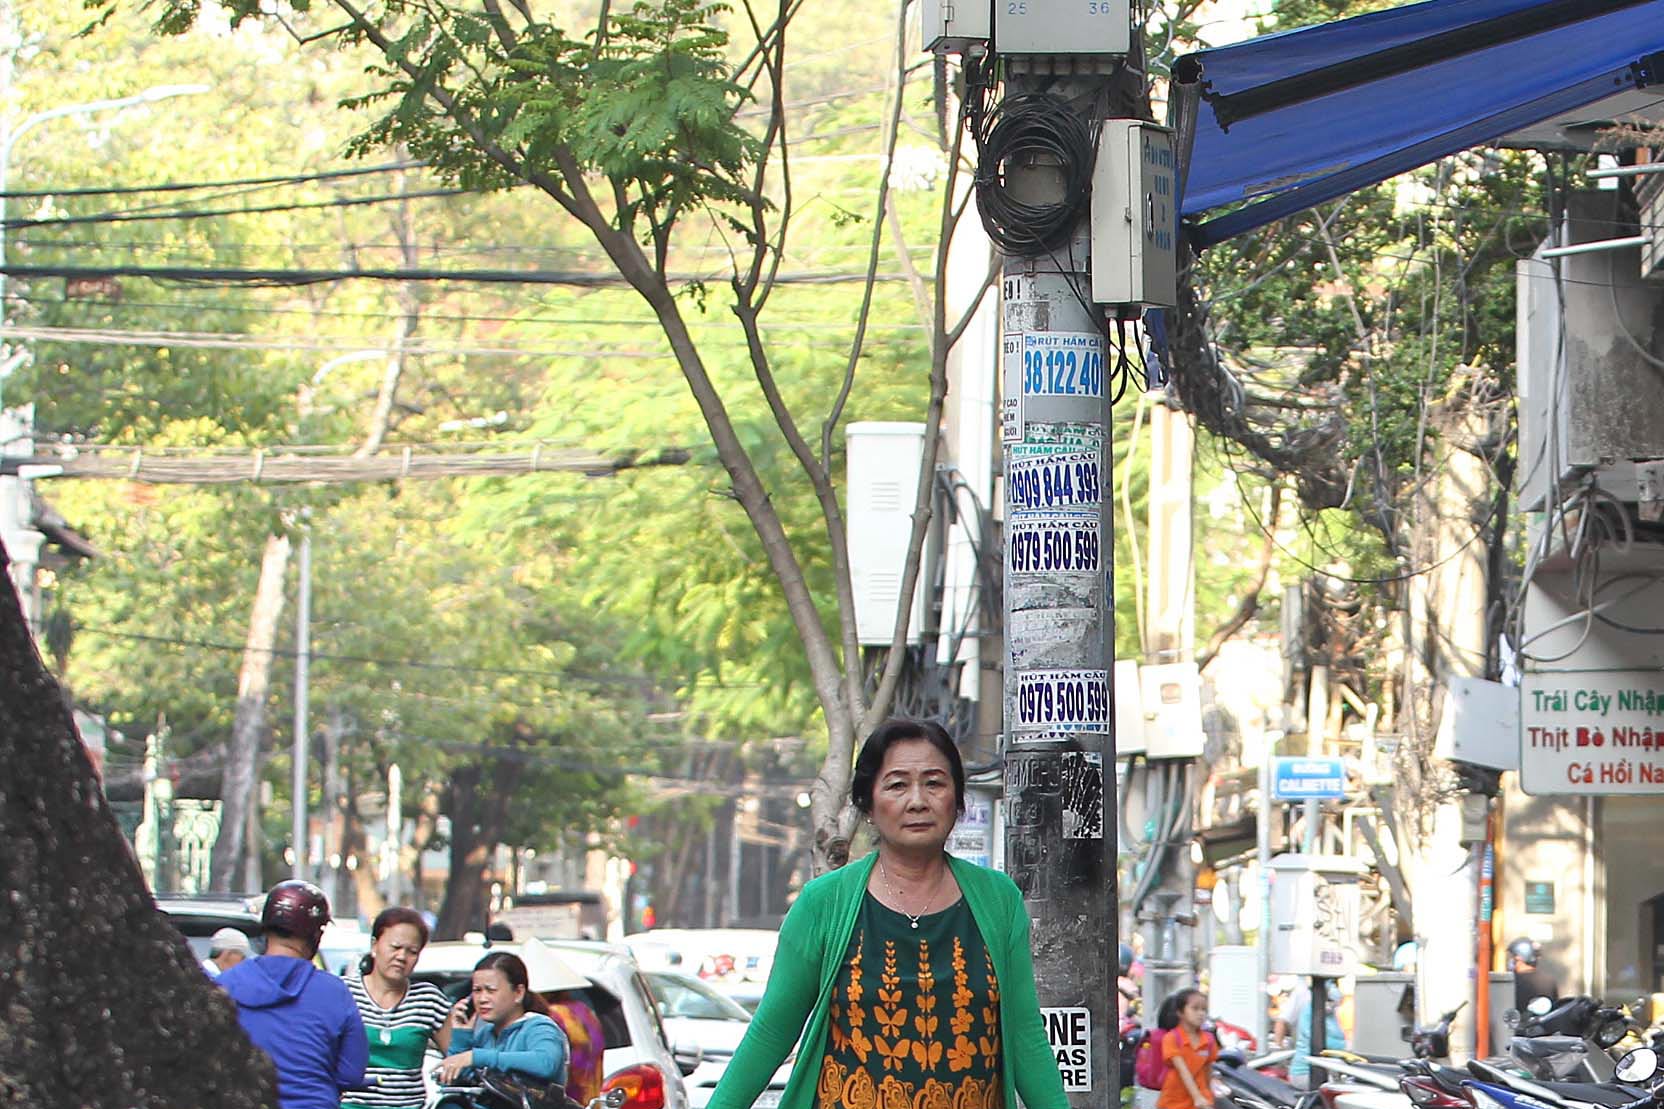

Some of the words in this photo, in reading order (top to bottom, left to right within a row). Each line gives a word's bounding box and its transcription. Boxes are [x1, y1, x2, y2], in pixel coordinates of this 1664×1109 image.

[1008, 2, 1027, 14] 25
[1089, 2, 1110, 15] 36
[1012, 462, 1099, 508] 0909.844.393
[1012, 531, 1098, 571] 0979.500.599
[1020, 682, 1108, 722] 0979.500.599
[1532, 689, 1567, 711] Trái
[1574, 689, 1612, 716] Cây
[1528, 727, 1568, 752] Thịt
[1576, 726, 1604, 747] Bò
[1567, 762, 1593, 784] Cá
[1600, 758, 1632, 784] Hồi
